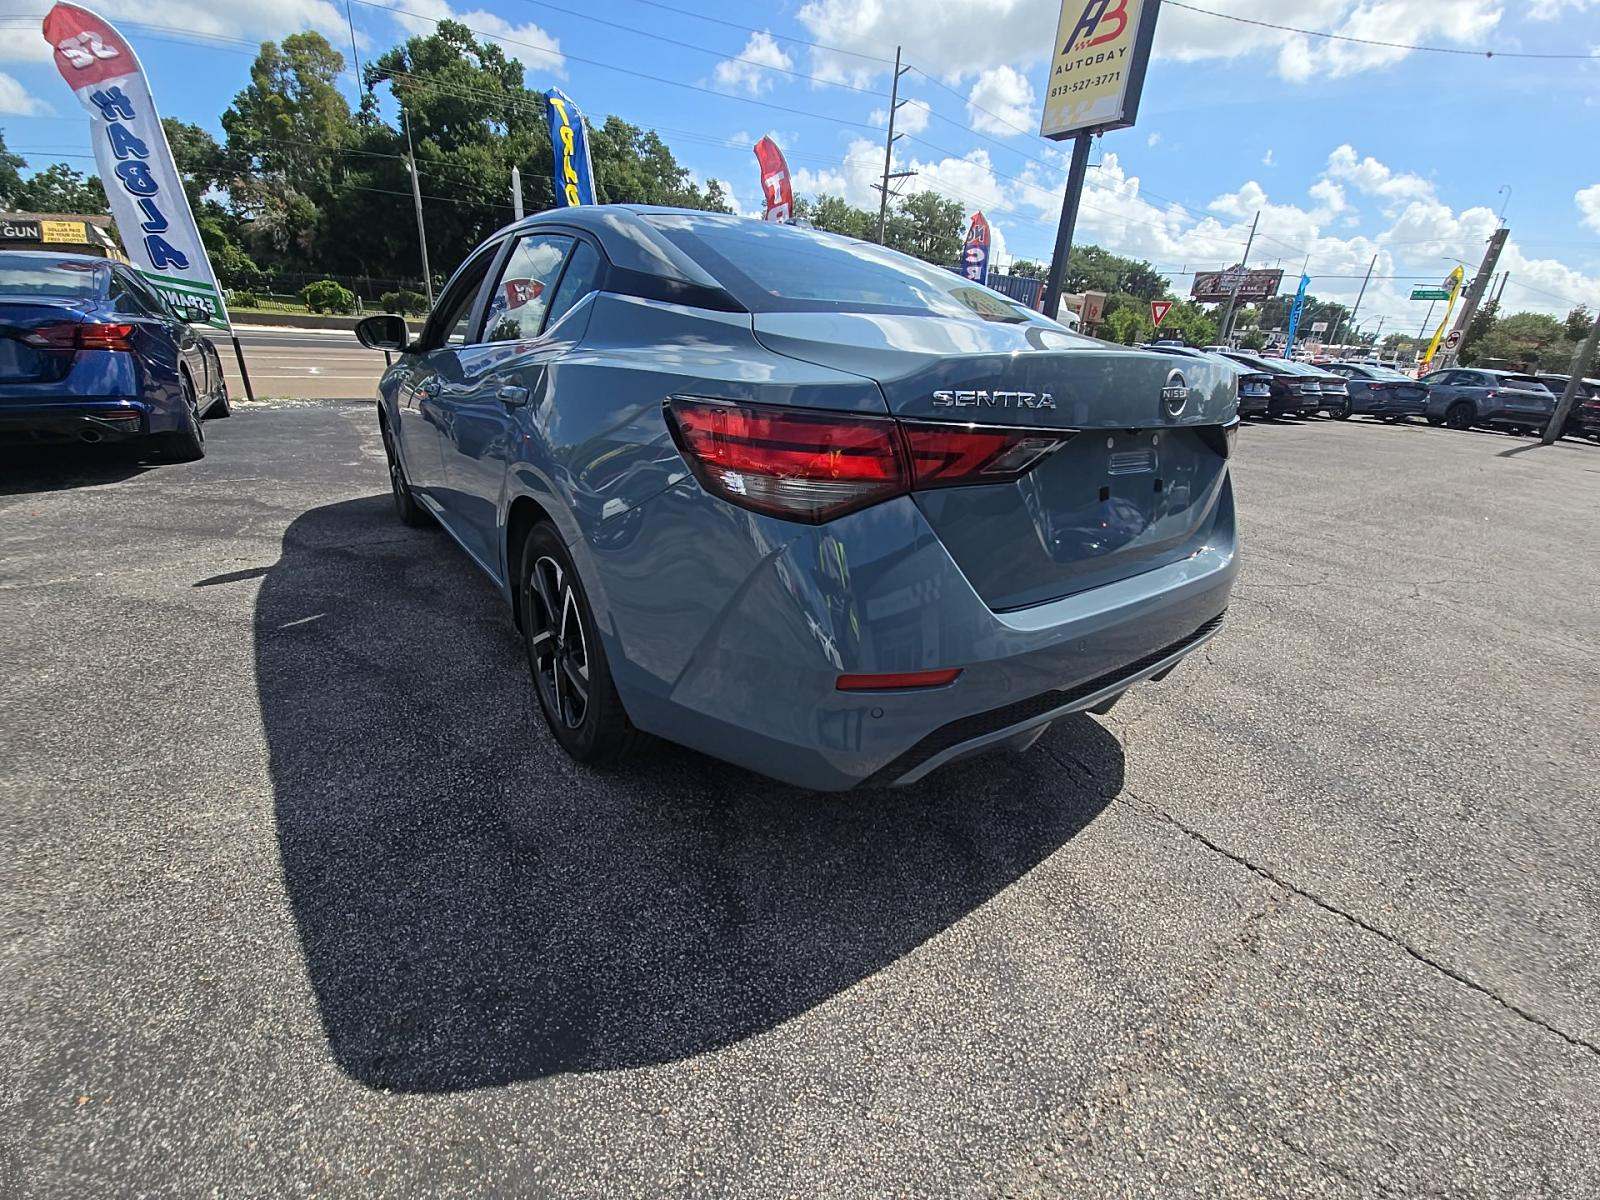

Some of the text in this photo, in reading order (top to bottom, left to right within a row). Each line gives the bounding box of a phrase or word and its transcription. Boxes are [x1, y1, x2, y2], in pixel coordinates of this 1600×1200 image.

[1055, 47, 1127, 75] AUTOBAY
[1051, 72, 1120, 97] 813-527-3771
[3, 227, 38, 237] GUN
[933, 390, 1056, 409] SENTRA
